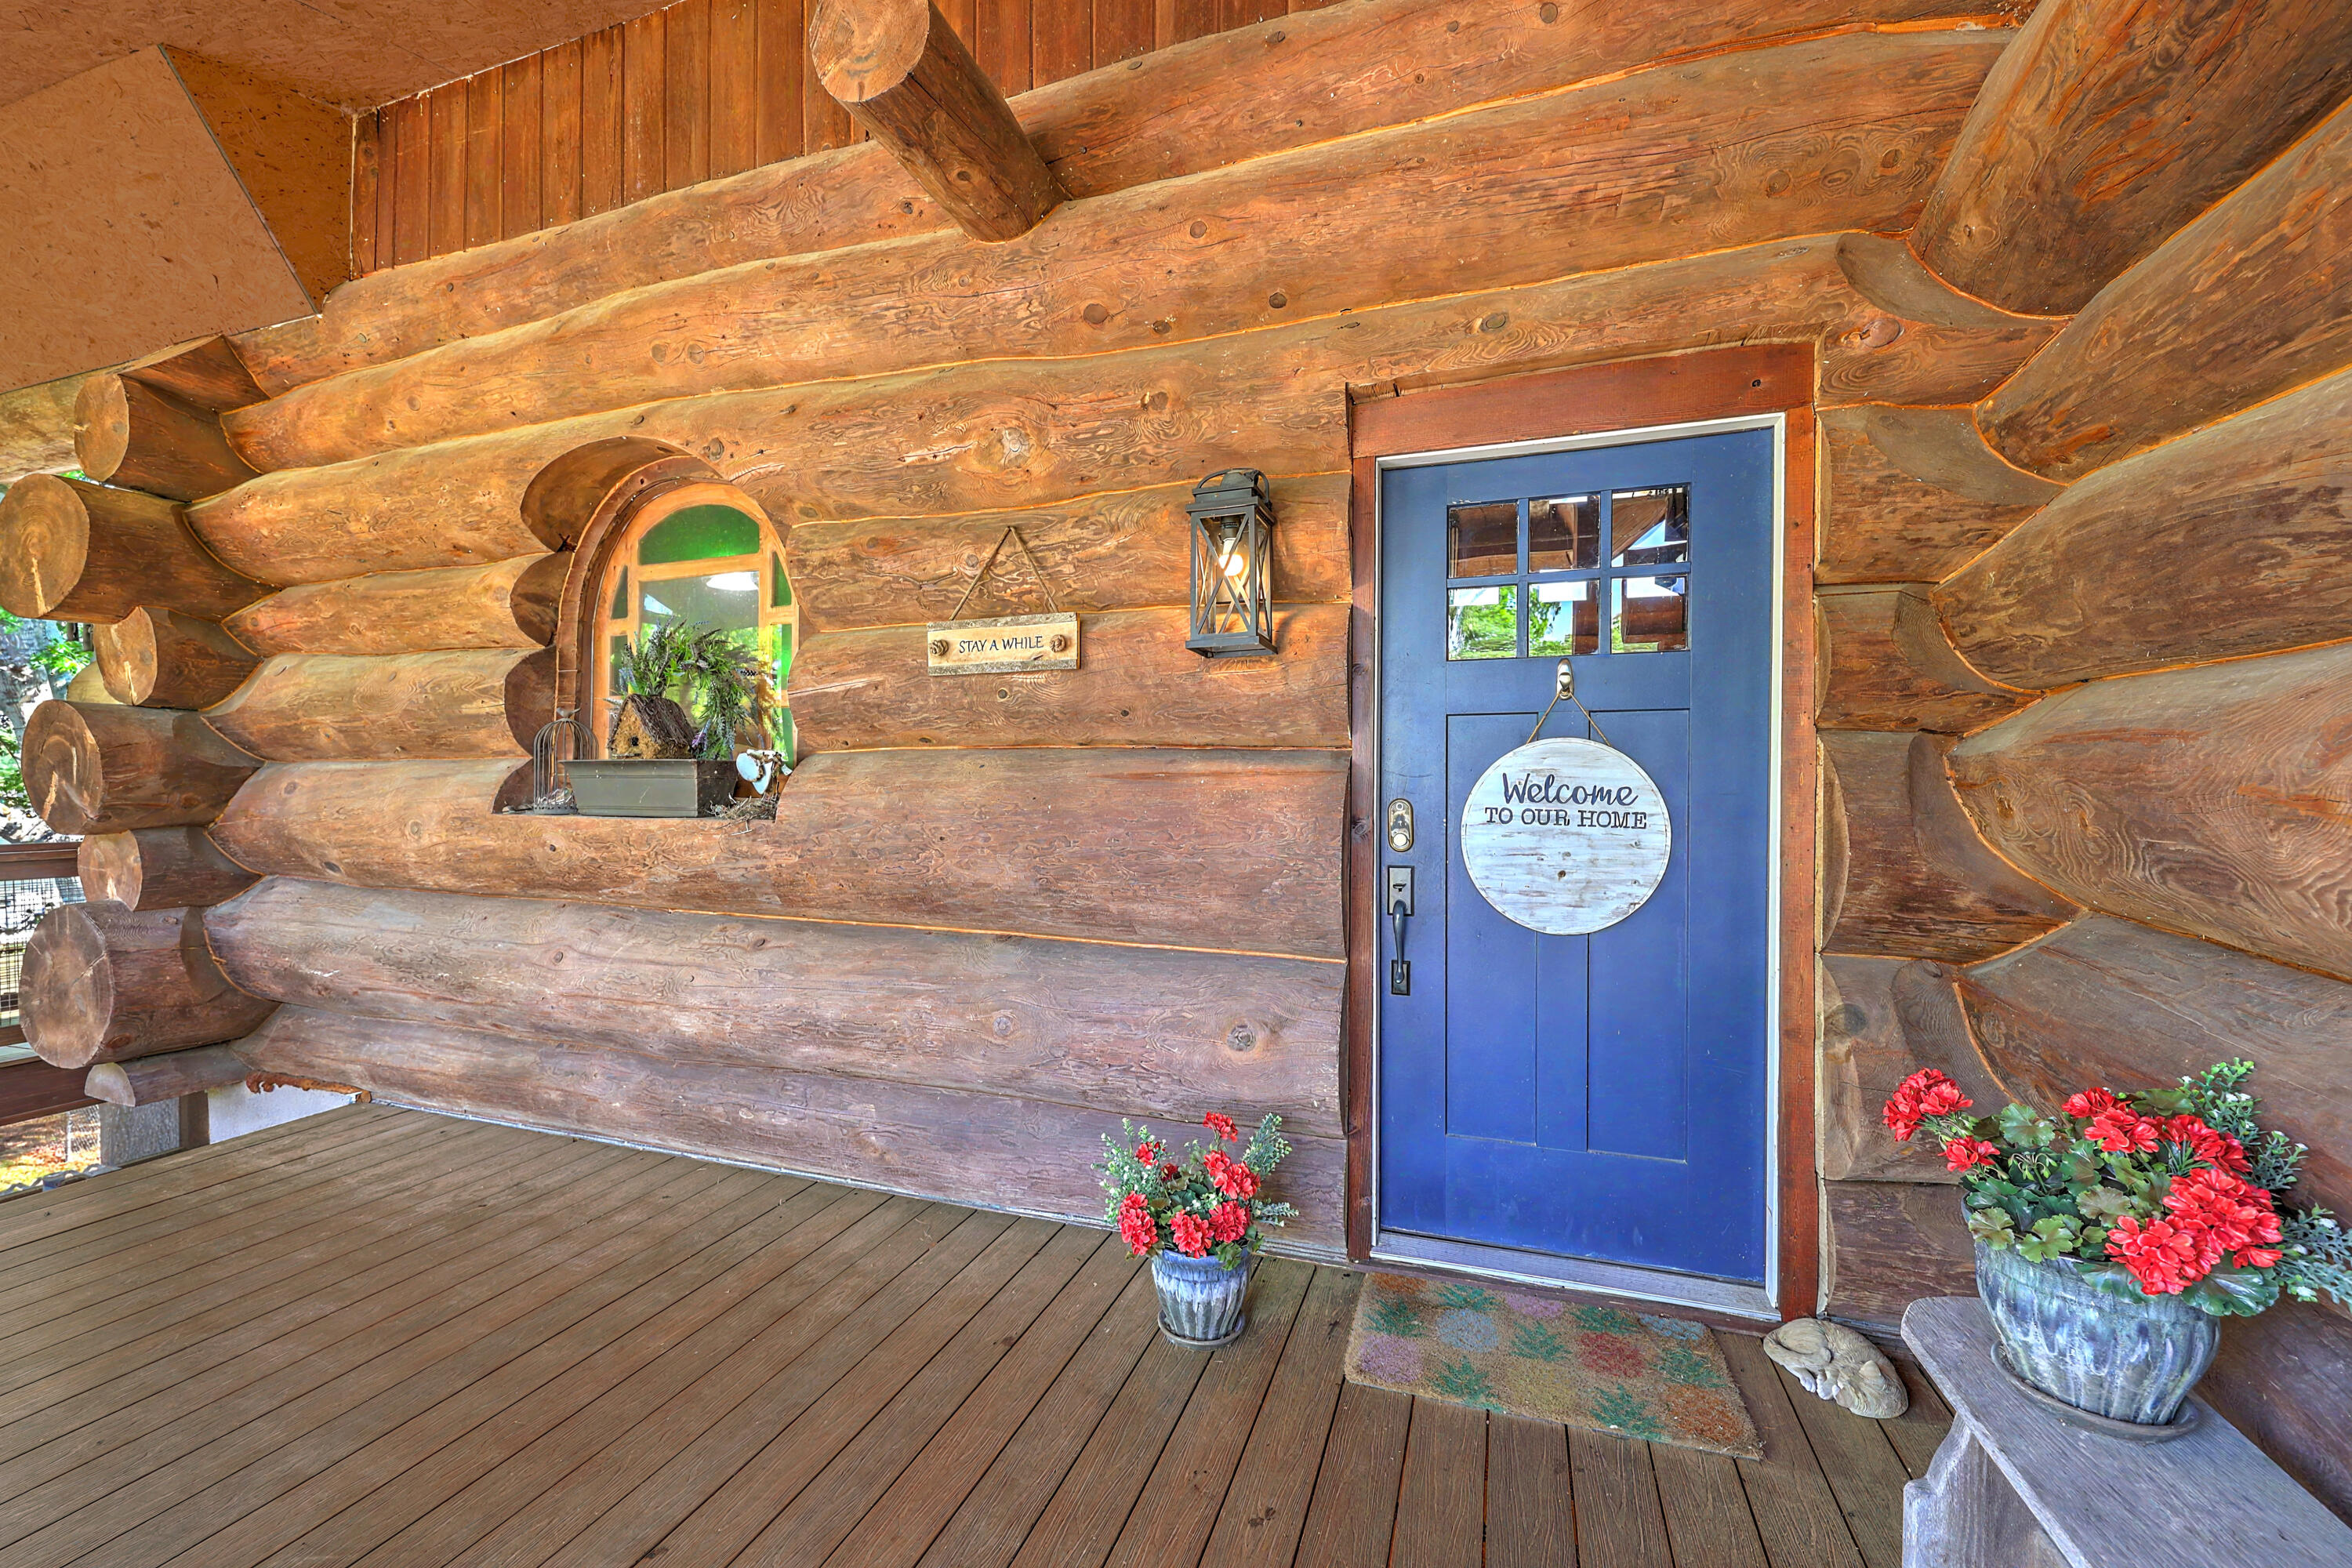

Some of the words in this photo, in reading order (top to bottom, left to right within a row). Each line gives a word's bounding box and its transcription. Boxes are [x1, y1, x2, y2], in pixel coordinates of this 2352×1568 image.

[959, 639, 987, 654] STAY
[989, 639, 999, 651] A
[1001, 636, 1044, 651] WHILE
[1502, 772, 1639, 806] Welcome
[1485, 807, 1513, 824] TO
[1521, 808, 1570, 826] OUR
[1577, 809, 1647, 829] HOME
